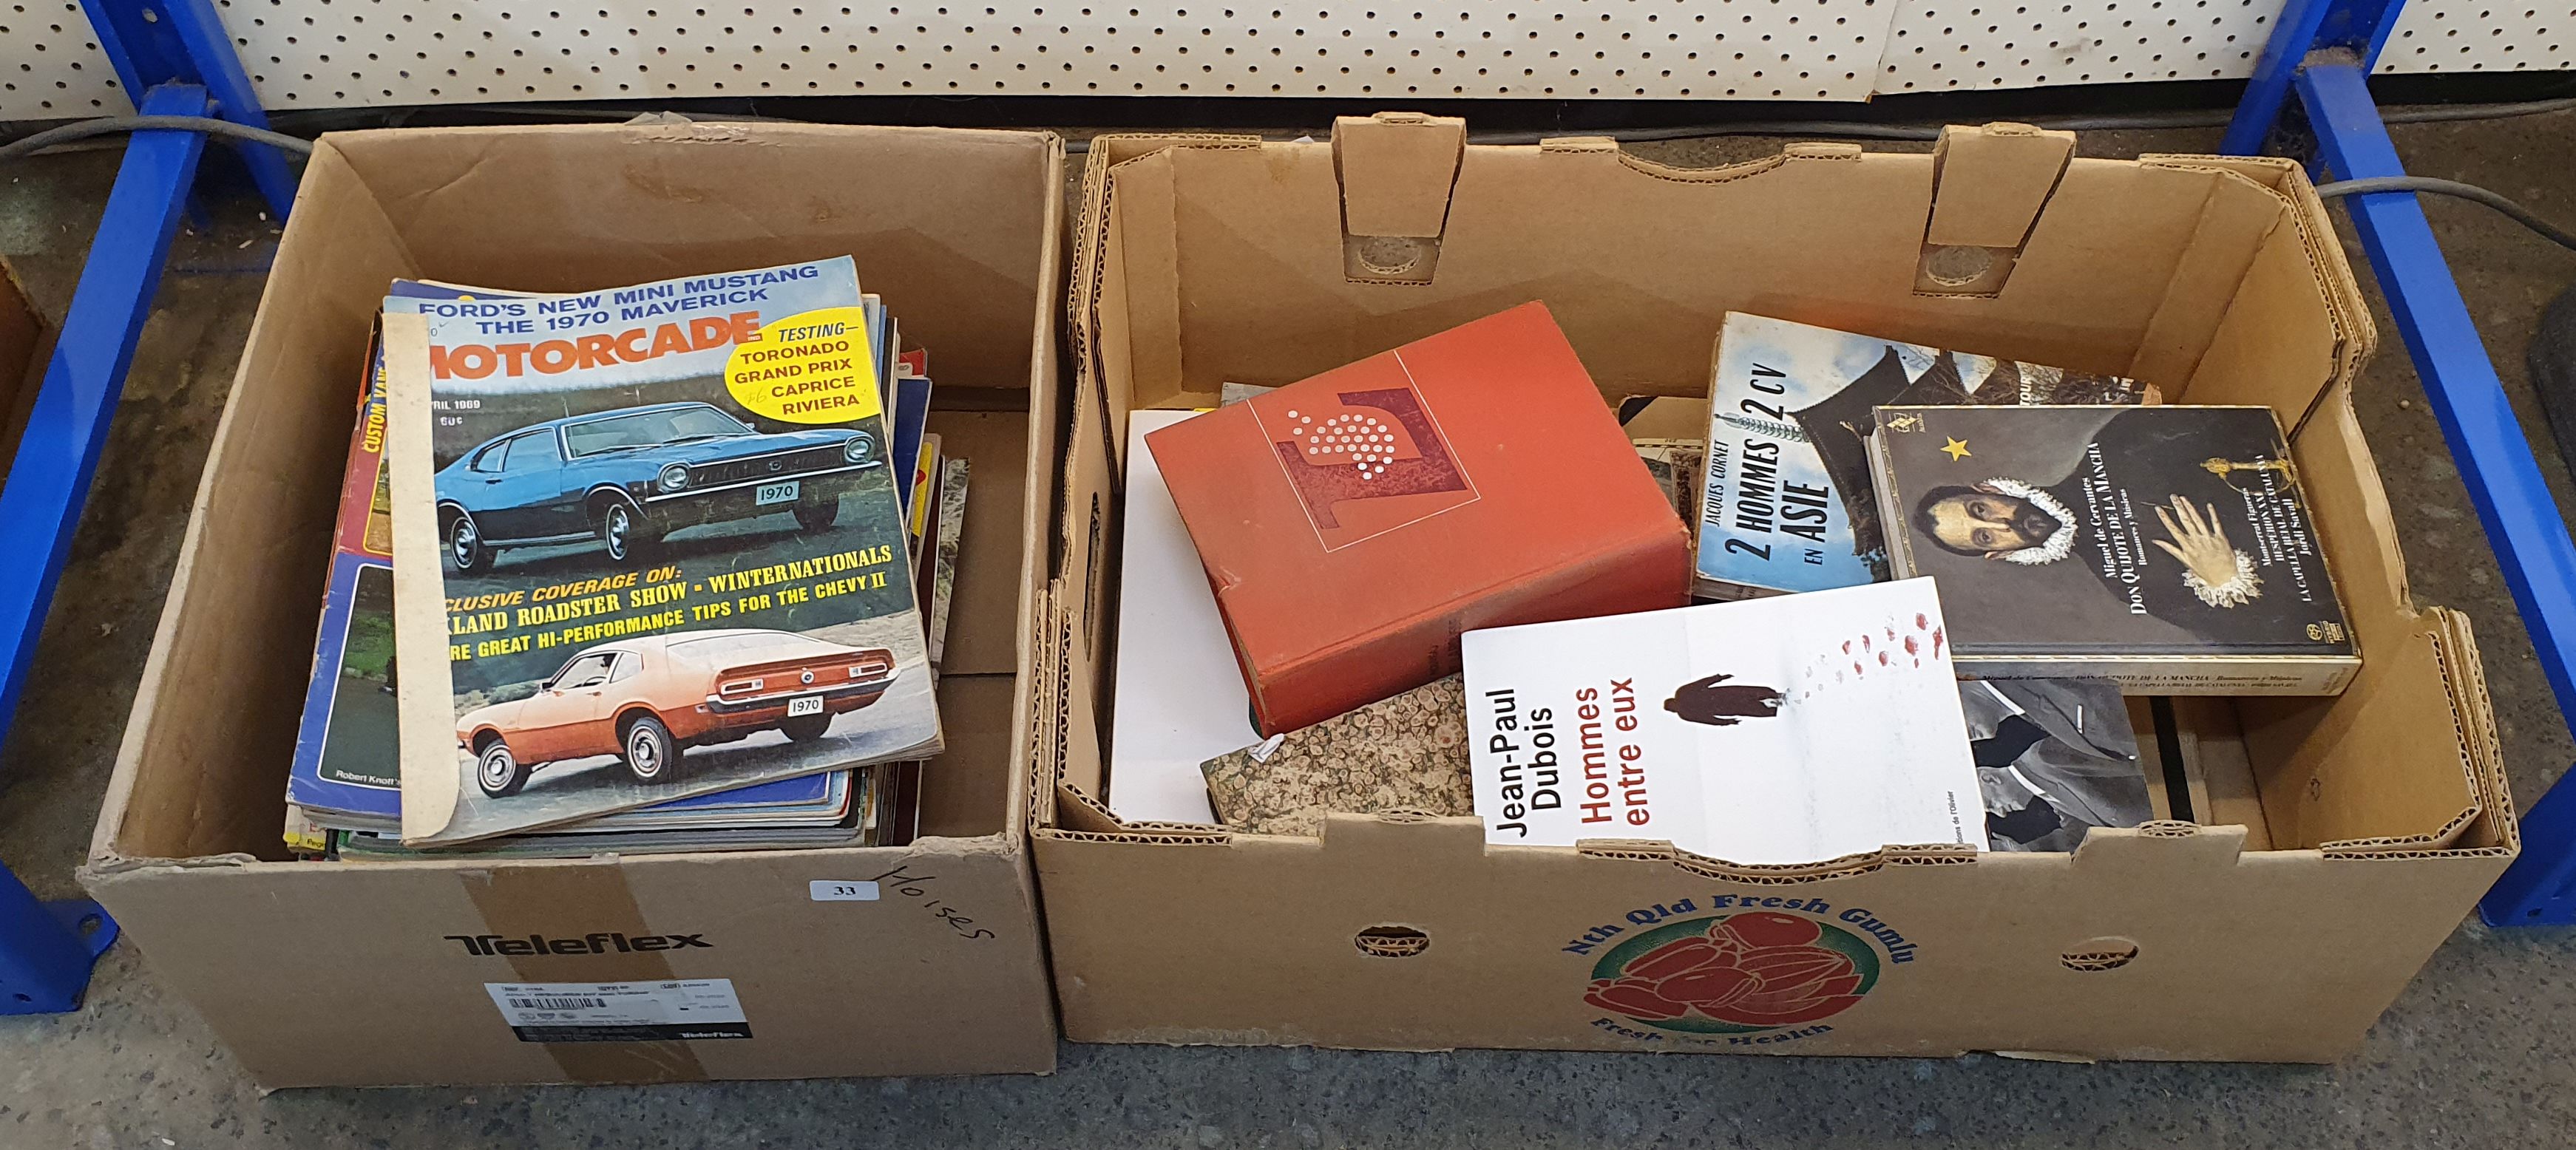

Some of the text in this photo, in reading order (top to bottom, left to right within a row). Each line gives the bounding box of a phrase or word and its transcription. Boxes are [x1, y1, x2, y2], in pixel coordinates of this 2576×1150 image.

[419, 265, 818, 317] FORD'S NEW MINI MUSTANG
[475, 288, 770, 334] THE 1970 MAVERICK
[734, 358, 853, 384] GRAND PRIX
[740, 341, 850, 364] TORONADO
[771, 375, 855, 398] CAPRICE
[1749, 362, 1786, 395] CV
[431, 400, 481, 410] RIL 1969
[782, 394, 860, 415] RIVIERA
[1740, 398, 1784, 421] 2
[362, 404, 386, 453] CUSTOM
[761, 485, 793, 500] 1970
[1704, 439, 1729, 528] JACQUES CORNET
[1735, 438, 1780, 534] HOMMES
[1779, 480, 1829, 565] EN ASIE
[2082, 477, 2118, 578] Miguel de Cervantes
[2087, 443, 2147, 614] DON QUIJOTE DE LA MANCHA
[2271, 504, 2283, 517] DE
[2282, 498, 2312, 556] Jordi Savall
[1724, 538, 1772, 562] 2
[2132, 526, 2148, 565] Romances
[2251, 523, 2273, 567] Montserrat
[517, 593, 621, 627] ROADSTER
[631, 582, 688, 608] SHOW
[708, 545, 892, 593] WINTERNATIONALS
[532, 572, 639, 602] COVERAGE
[646, 565, 682, 584] ON:
[2286, 547, 2307, 588] CAPELLA
[478, 635, 531, 659] GREAT
[538, 609, 684, 650] HI-PERFORMANCE
[692, 602, 732, 621] TIPS
[739, 594, 771, 614] FOR
[776, 587, 809, 606] THE
[815, 575, 867, 599] CHEVY
[869, 571, 887, 589] II
[2299, 589, 2313, 602] LA
[793, 699, 819, 712] 1970
[1485, 688, 1528, 838] Jean-Paul
[1523, 707, 1562, 810] Dubois
[1576, 687, 1613, 823] Hommes
[1610, 677, 1650, 826] entre eux
[336, 769, 367, 783] Robert
[1952, 816, 1960, 825] de
[833, 885, 856, 896] 33
[443, 932, 714, 956] Teleflex
[1561, 894, 1918, 964] Nth Qld Fresh Gumlu
[1728, 1024, 1834, 1046] Health
